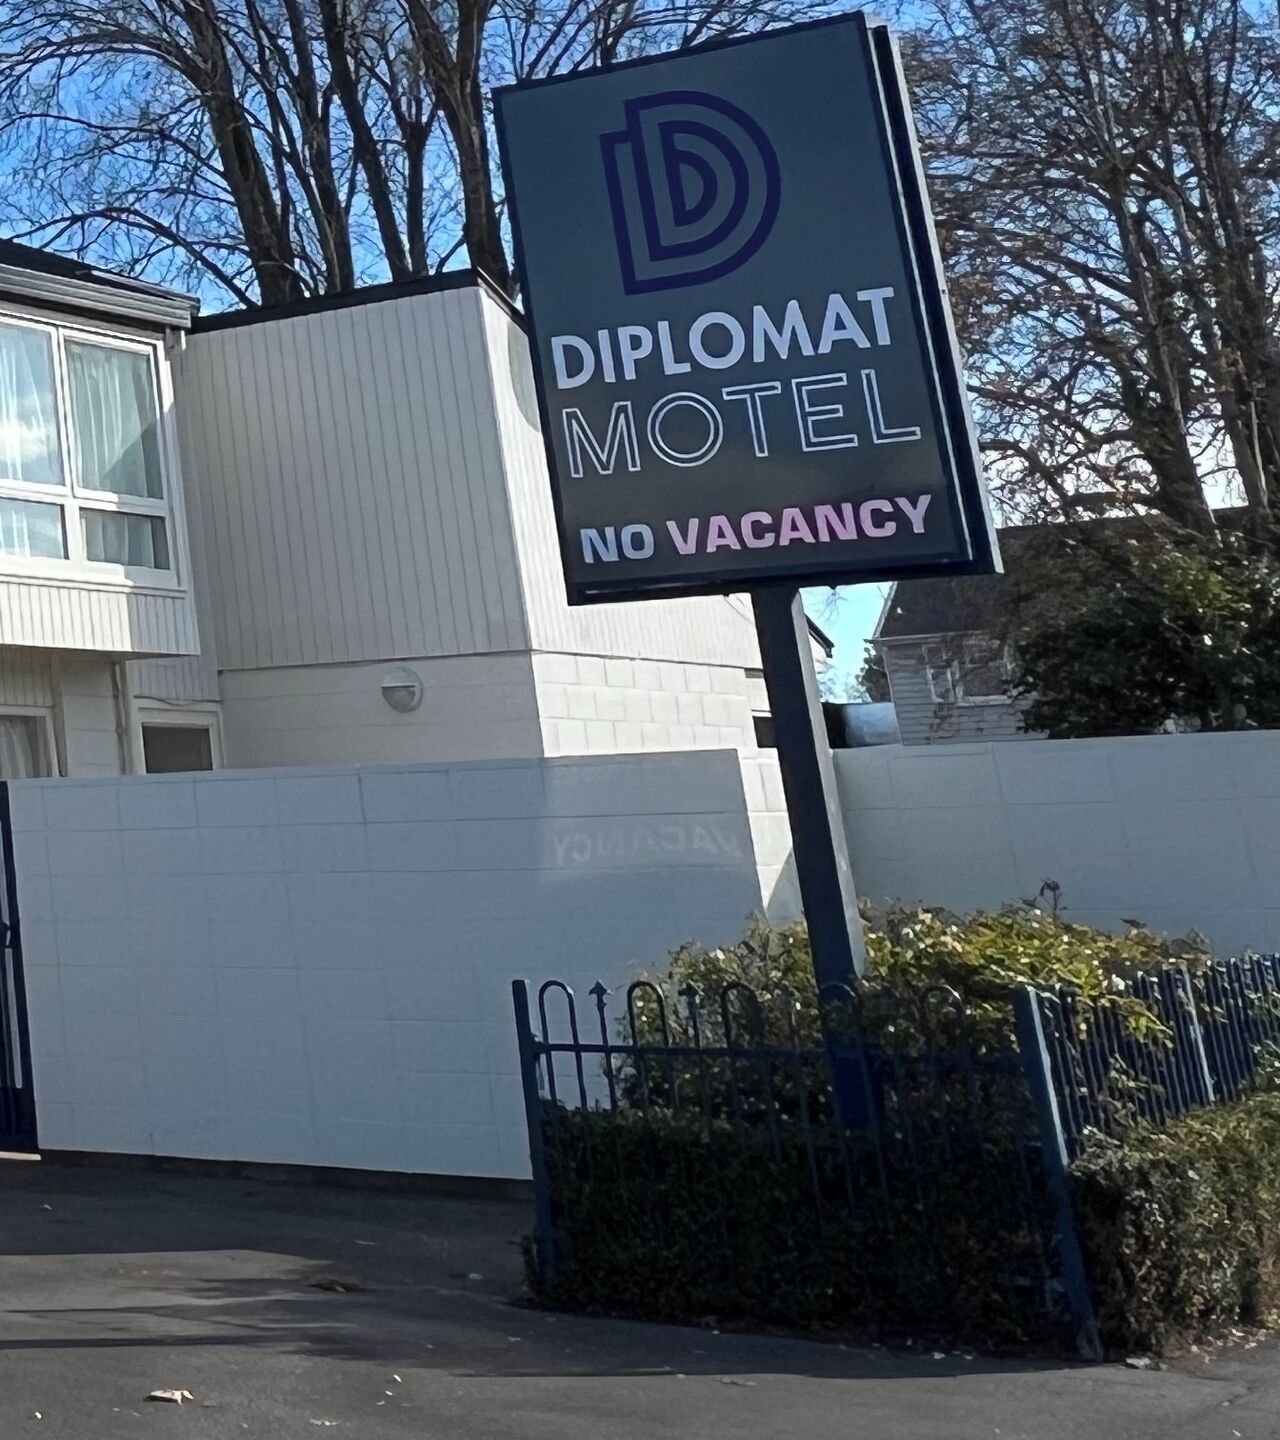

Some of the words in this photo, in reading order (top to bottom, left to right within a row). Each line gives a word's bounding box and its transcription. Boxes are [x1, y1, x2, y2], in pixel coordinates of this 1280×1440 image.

[551, 287, 895, 389] DIPLOMAT
[562, 368, 921, 479] MOTEL
[580, 524, 655, 564] NO
[666, 494, 932, 555] VACANCY
